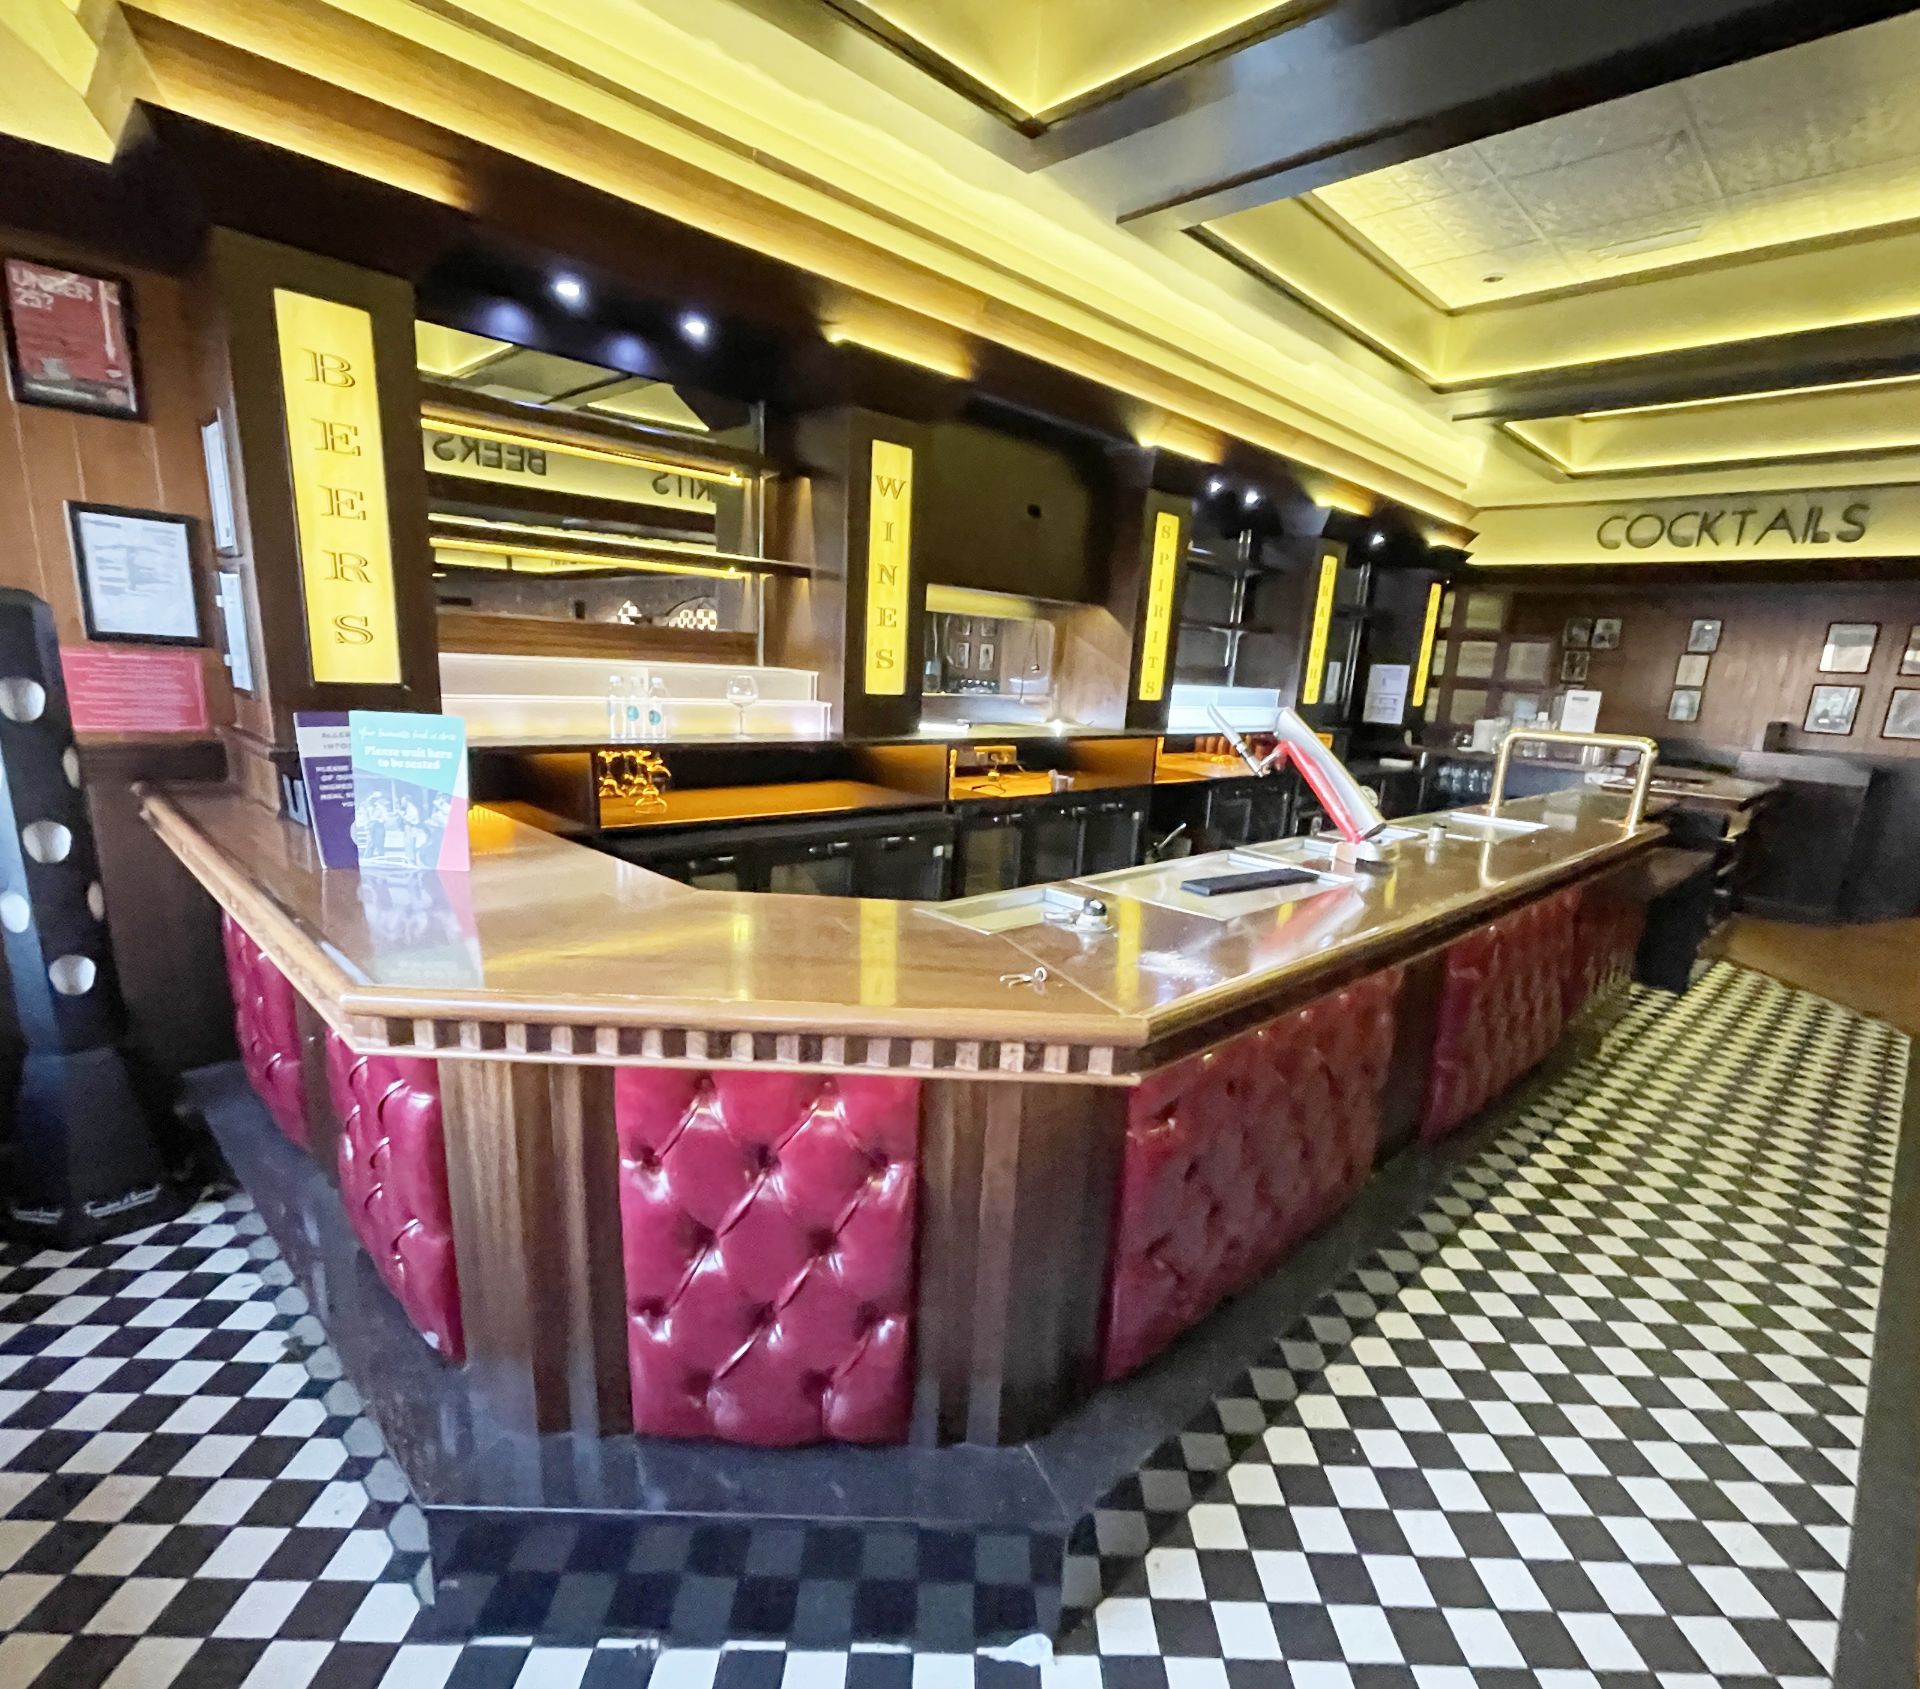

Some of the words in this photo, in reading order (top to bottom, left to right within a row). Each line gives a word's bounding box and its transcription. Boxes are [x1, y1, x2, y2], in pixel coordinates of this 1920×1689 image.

[301, 347, 374, 645] BEERS
[875, 474, 907, 669] WINES
[1597, 503, 1870, 550] COCKTAILS
[1145, 524, 1171, 694] SPIRITS
[1308, 564, 1332, 698] DRAUGHT
[364, 745, 399, 757] Please
